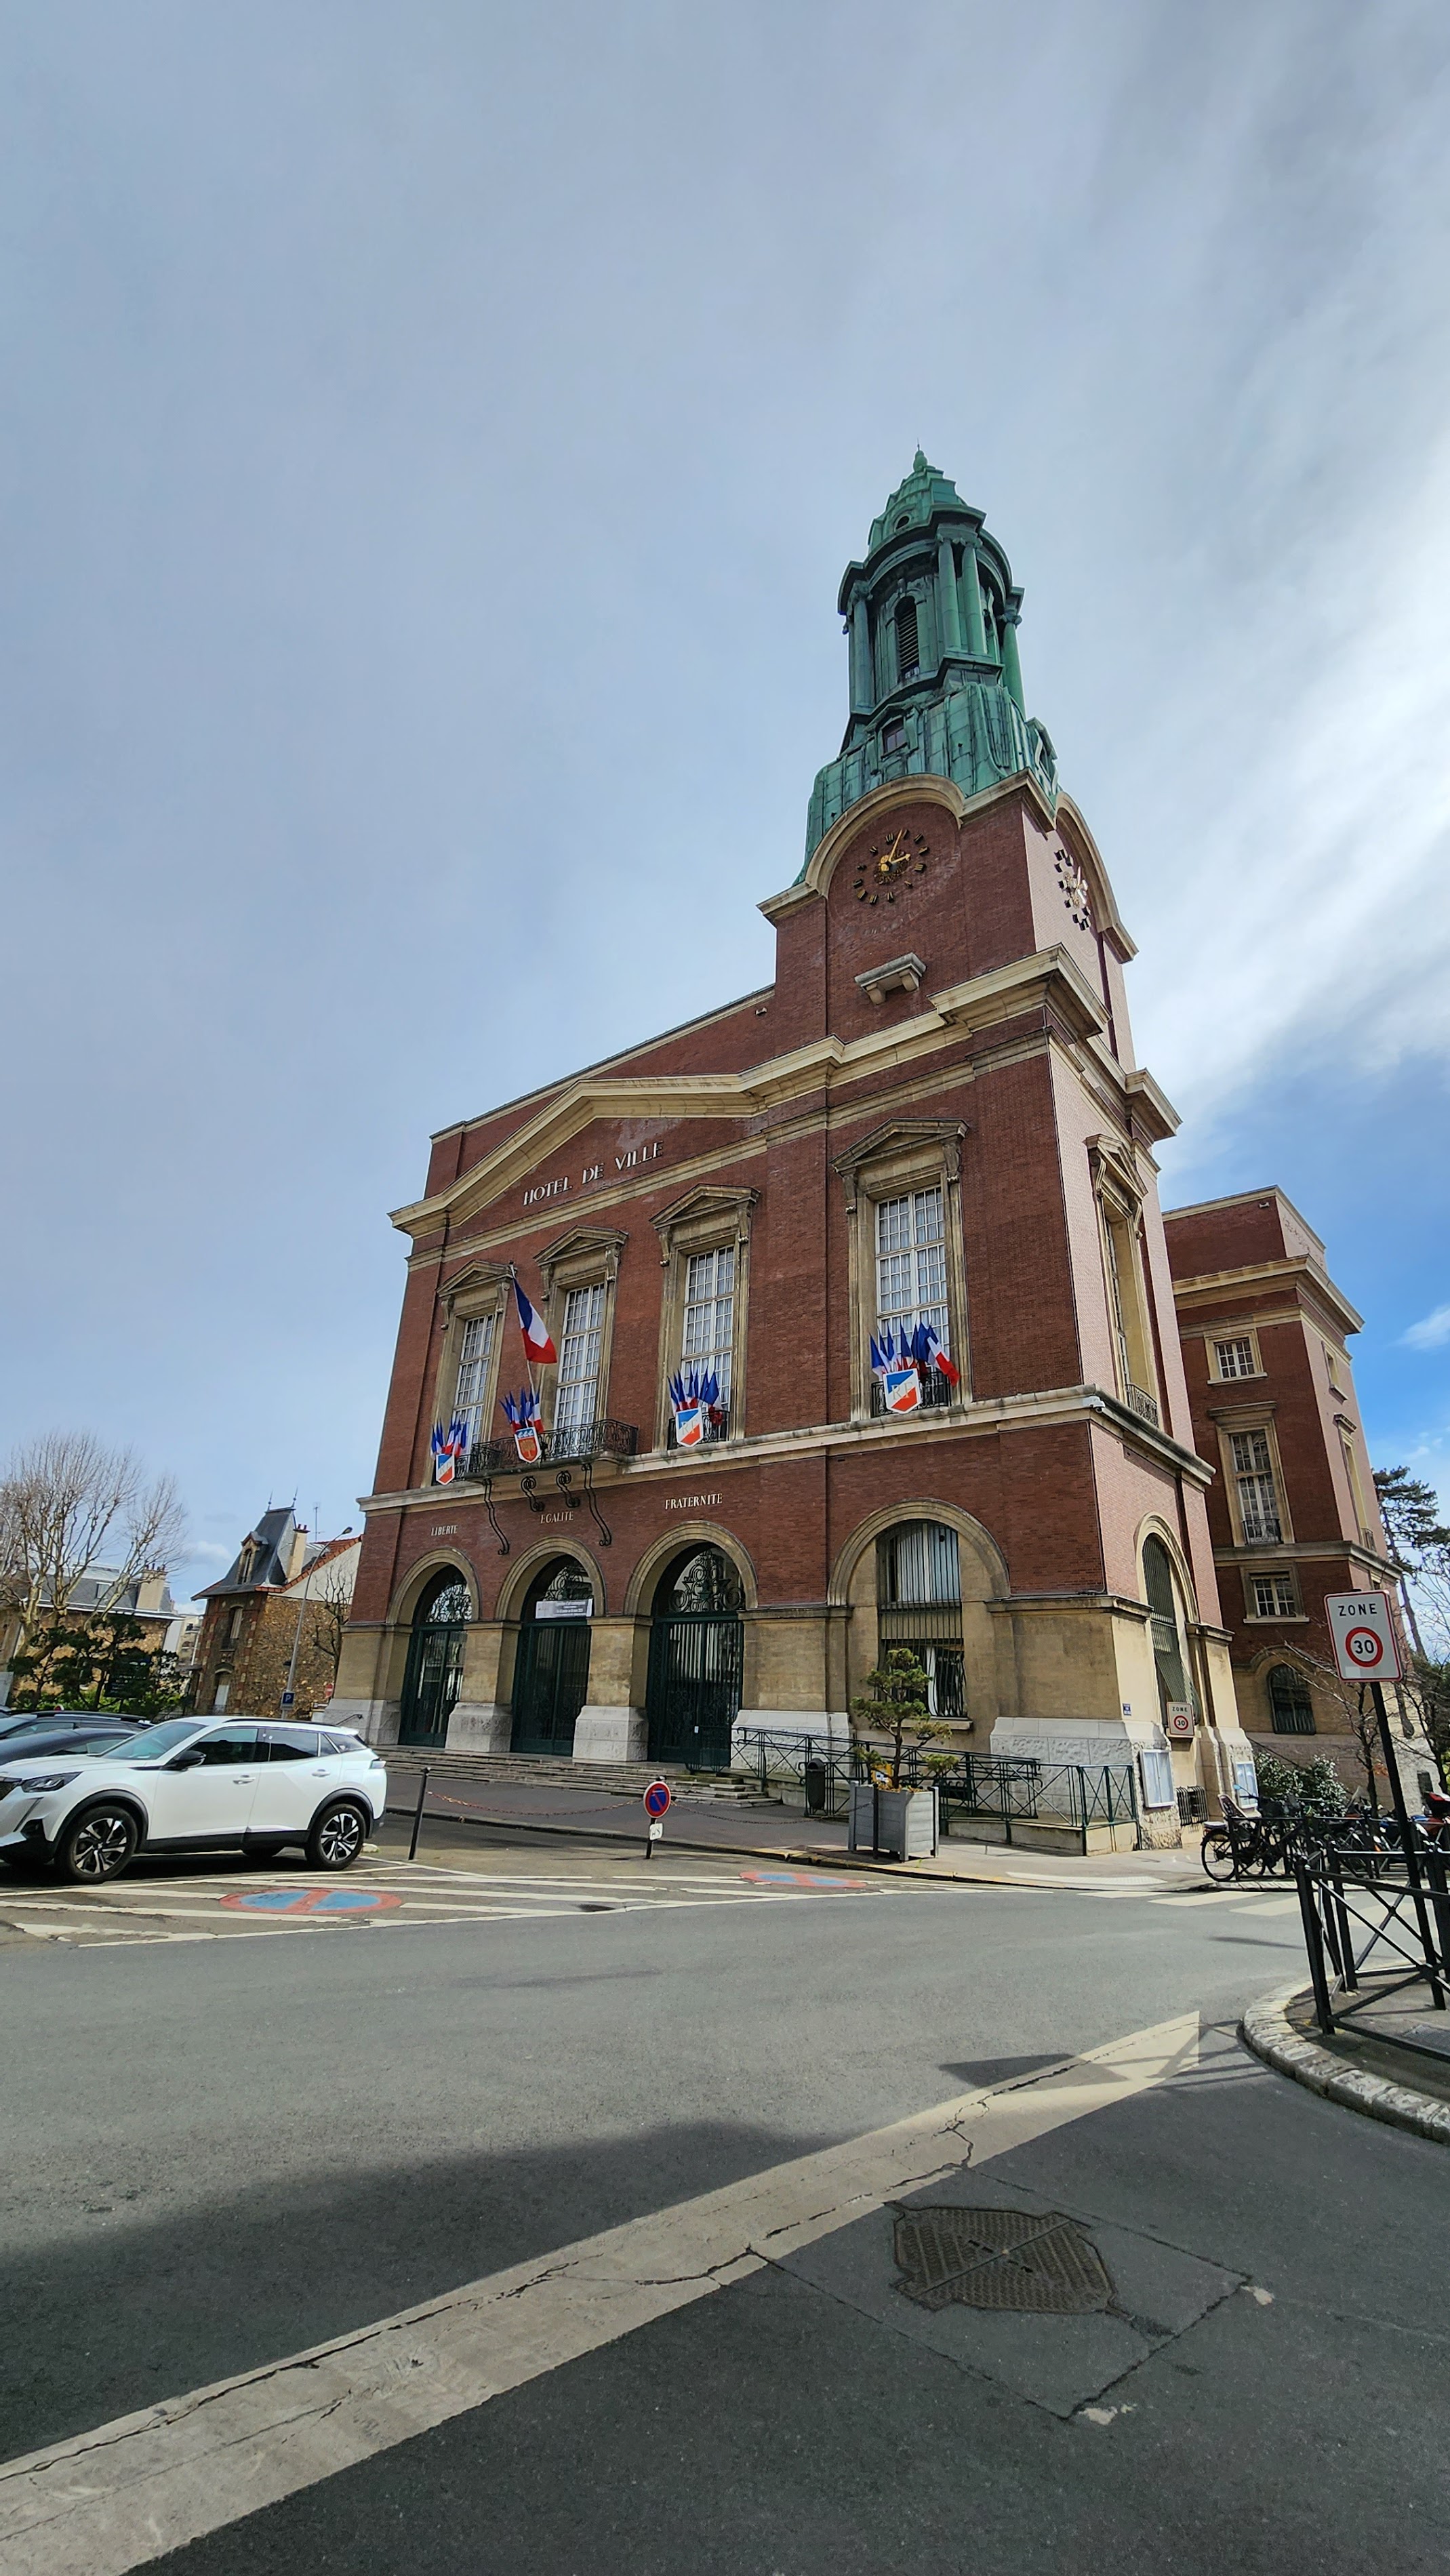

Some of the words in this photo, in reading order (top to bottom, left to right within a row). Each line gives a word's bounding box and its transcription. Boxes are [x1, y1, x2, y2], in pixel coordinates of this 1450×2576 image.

[523, 1176, 572, 1206] HOTEL
[582, 1162, 605, 1184] DE
[615, 1140, 664, 1171] VILLE
[665, 1493, 723, 1510] FRATERNITE
[540, 1511, 574, 1524] EGALITE
[430, 1525, 458, 1536] LIBERTE
[1337, 1603, 1377, 1617] ZONE
[1353, 1639, 1375, 1654] 30
[285, 1694, 292, 1702] P
